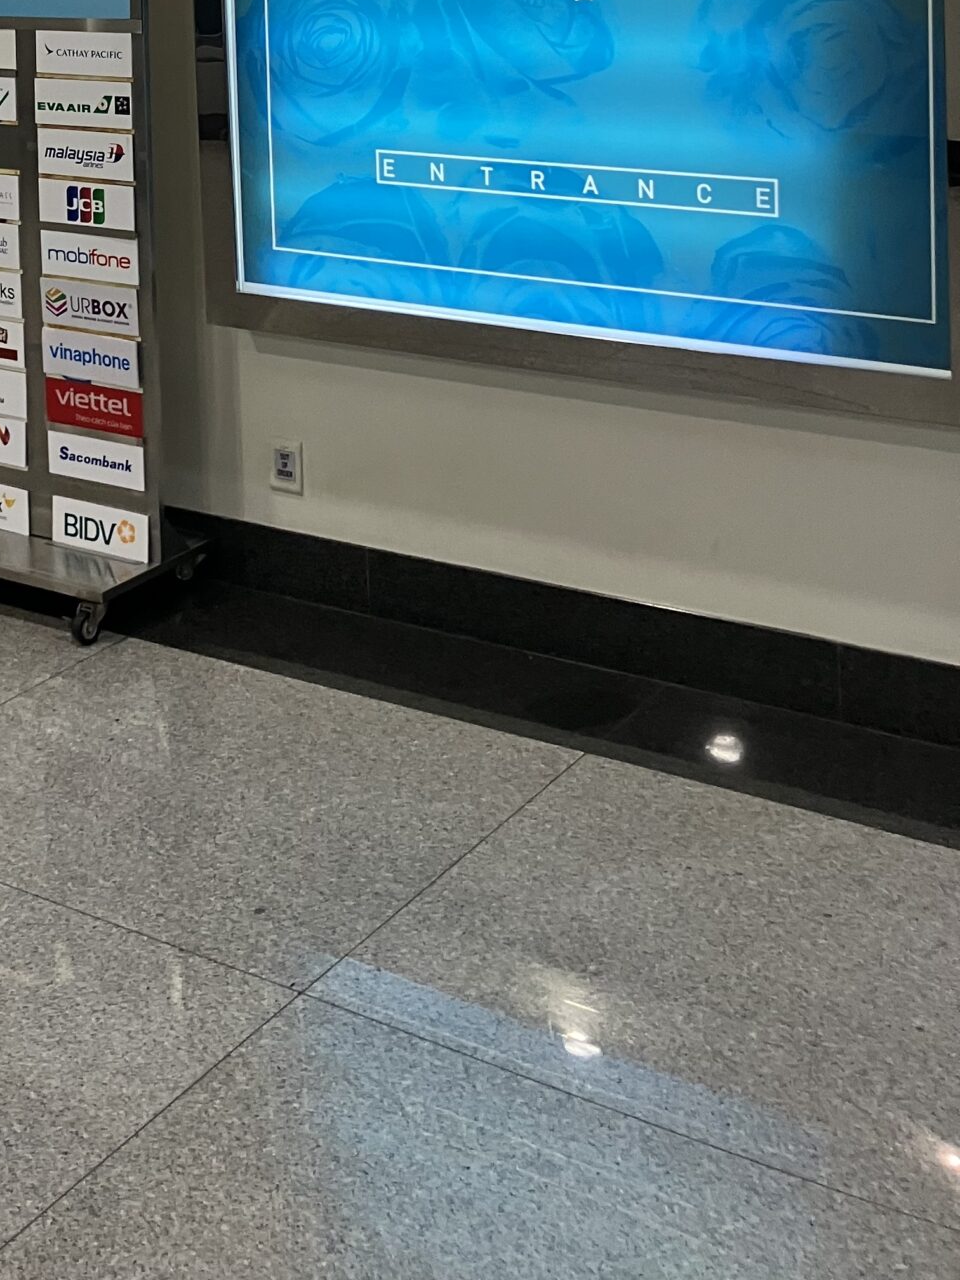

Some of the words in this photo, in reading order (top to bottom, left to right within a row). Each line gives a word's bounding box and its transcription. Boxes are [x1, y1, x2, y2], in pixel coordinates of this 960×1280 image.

[56, 47, 89, 59] CATHAY
[90, 49, 123, 60] PACIFIC
[44, 145, 106, 166] malaysia
[82, 160, 104, 169] airlines
[382, 158, 771, 210] ENTRANCE
[66, 197, 104, 213] JCB
[47, 246, 131, 269] mobifone
[70, 297, 129, 320] URBOX
[49, 343, 131, 371] vinaphone
[55, 387, 132, 417] viettel
[58, 446, 133, 473] Sacombank
[64, 512, 117, 545] BIDV
